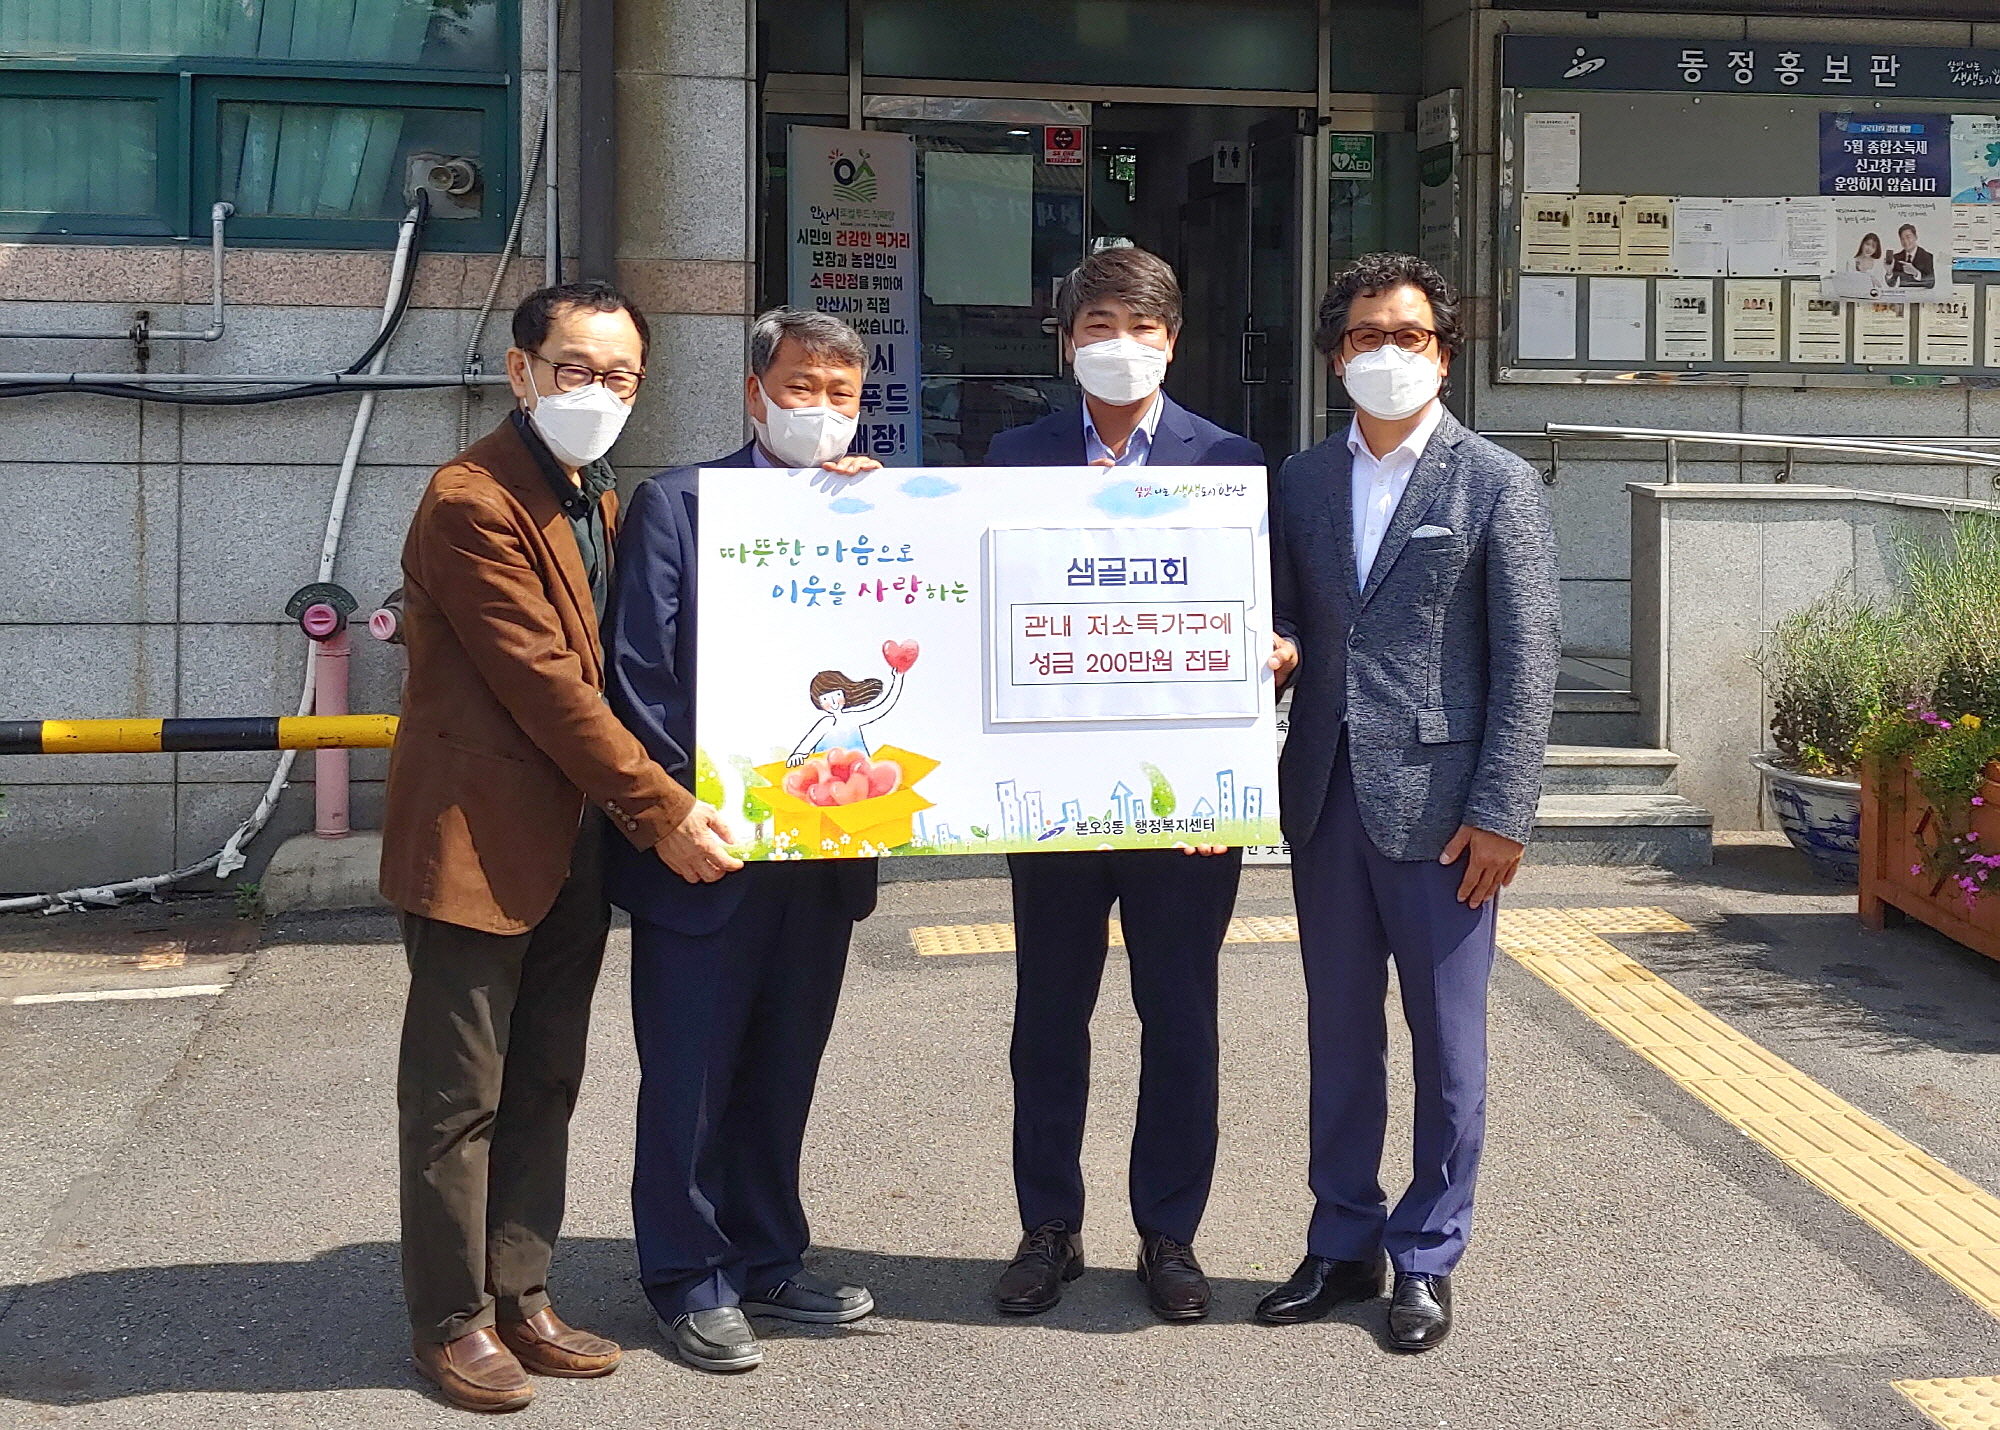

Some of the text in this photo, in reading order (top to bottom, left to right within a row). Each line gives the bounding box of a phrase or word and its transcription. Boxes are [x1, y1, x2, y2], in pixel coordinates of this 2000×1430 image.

[1843, 140, 1928, 155] 5월 종합소득세
[1347, 160, 1371, 171] AED
[1854, 158, 1916, 174] 신고창구를
[1834, 176, 1937, 192] 운영하지 않습니다
[796, 228, 910, 249] 시민의 건강한 먹거리
[812, 250, 897, 270] 보장과 농업인의
[810, 272, 903, 291] 소득안정을 위하여
[816, 296, 890, 314] 안산시가 직접
[1218, 482, 1247, 497] 안산
[720, 534, 914, 567] 따뜻한 마음으로
[1067, 556, 1188, 587] 샘골교회
[772, 574, 969, 607] 이웃을 사랑하는
[1025, 612, 1232, 637] 관내 저소득가구에
[1029, 648, 1231, 676] 성금 200만원 전달
[1075, 817, 1215, 836] 본오3동 행정복지센터
